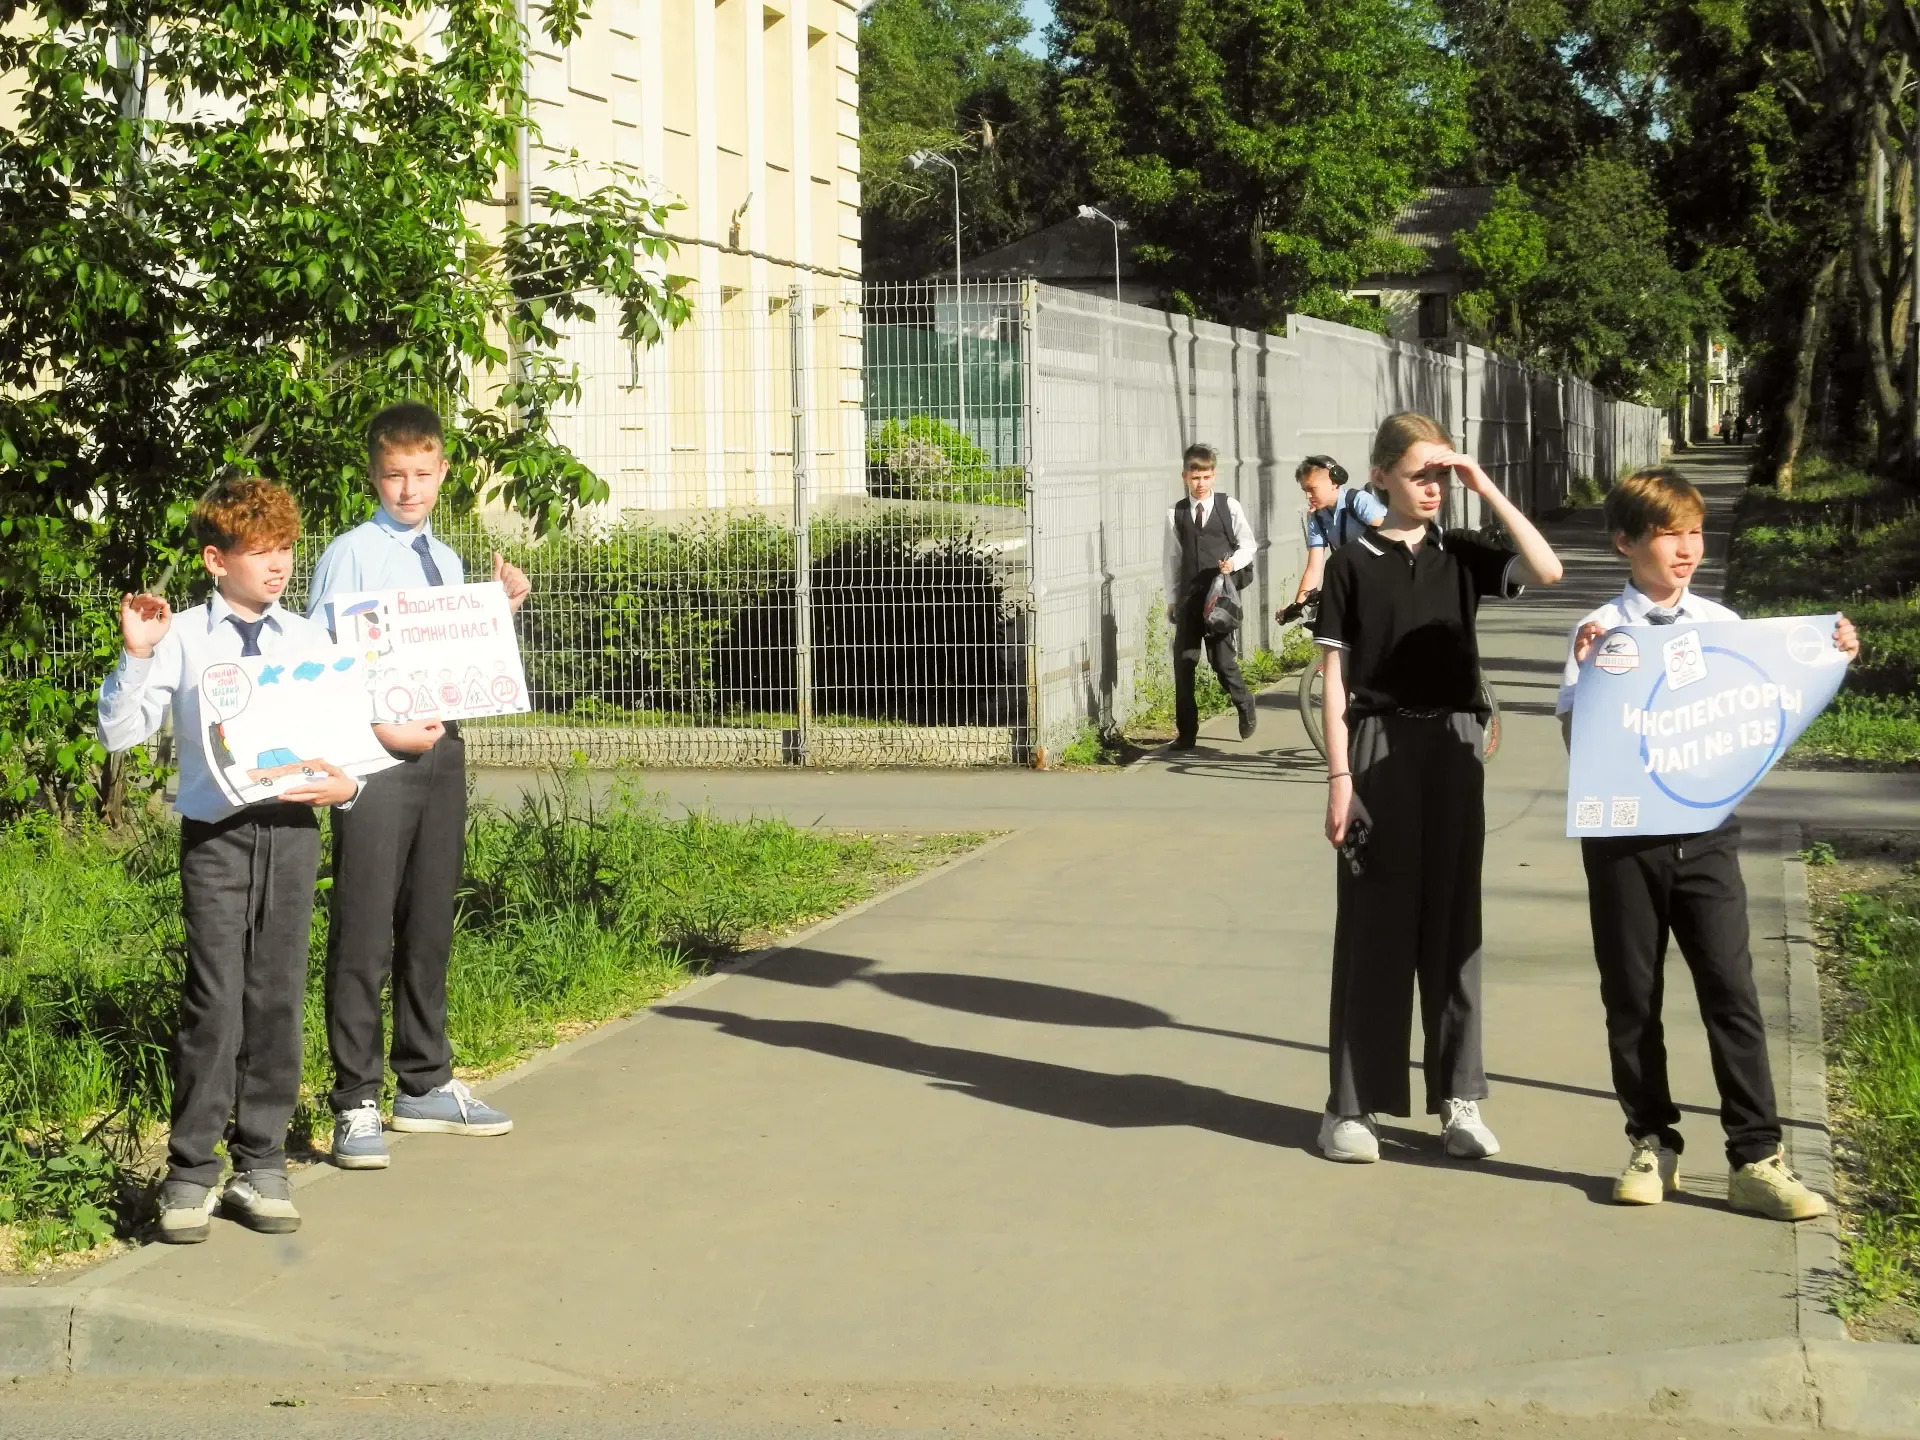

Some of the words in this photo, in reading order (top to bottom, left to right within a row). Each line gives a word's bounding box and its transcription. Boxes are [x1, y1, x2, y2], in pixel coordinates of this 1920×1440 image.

[401, 624, 447, 644] ПОМНИ
[448, 624, 458, 640] О
[1670, 637, 1689, 650] ЮИД
[1623, 682, 1803, 737] ИНСПЕКТОРЫ
[1644, 741, 1698, 774] ЛАП
[1704, 733, 1734, 760] №
[1739, 720, 1777, 749] 135
